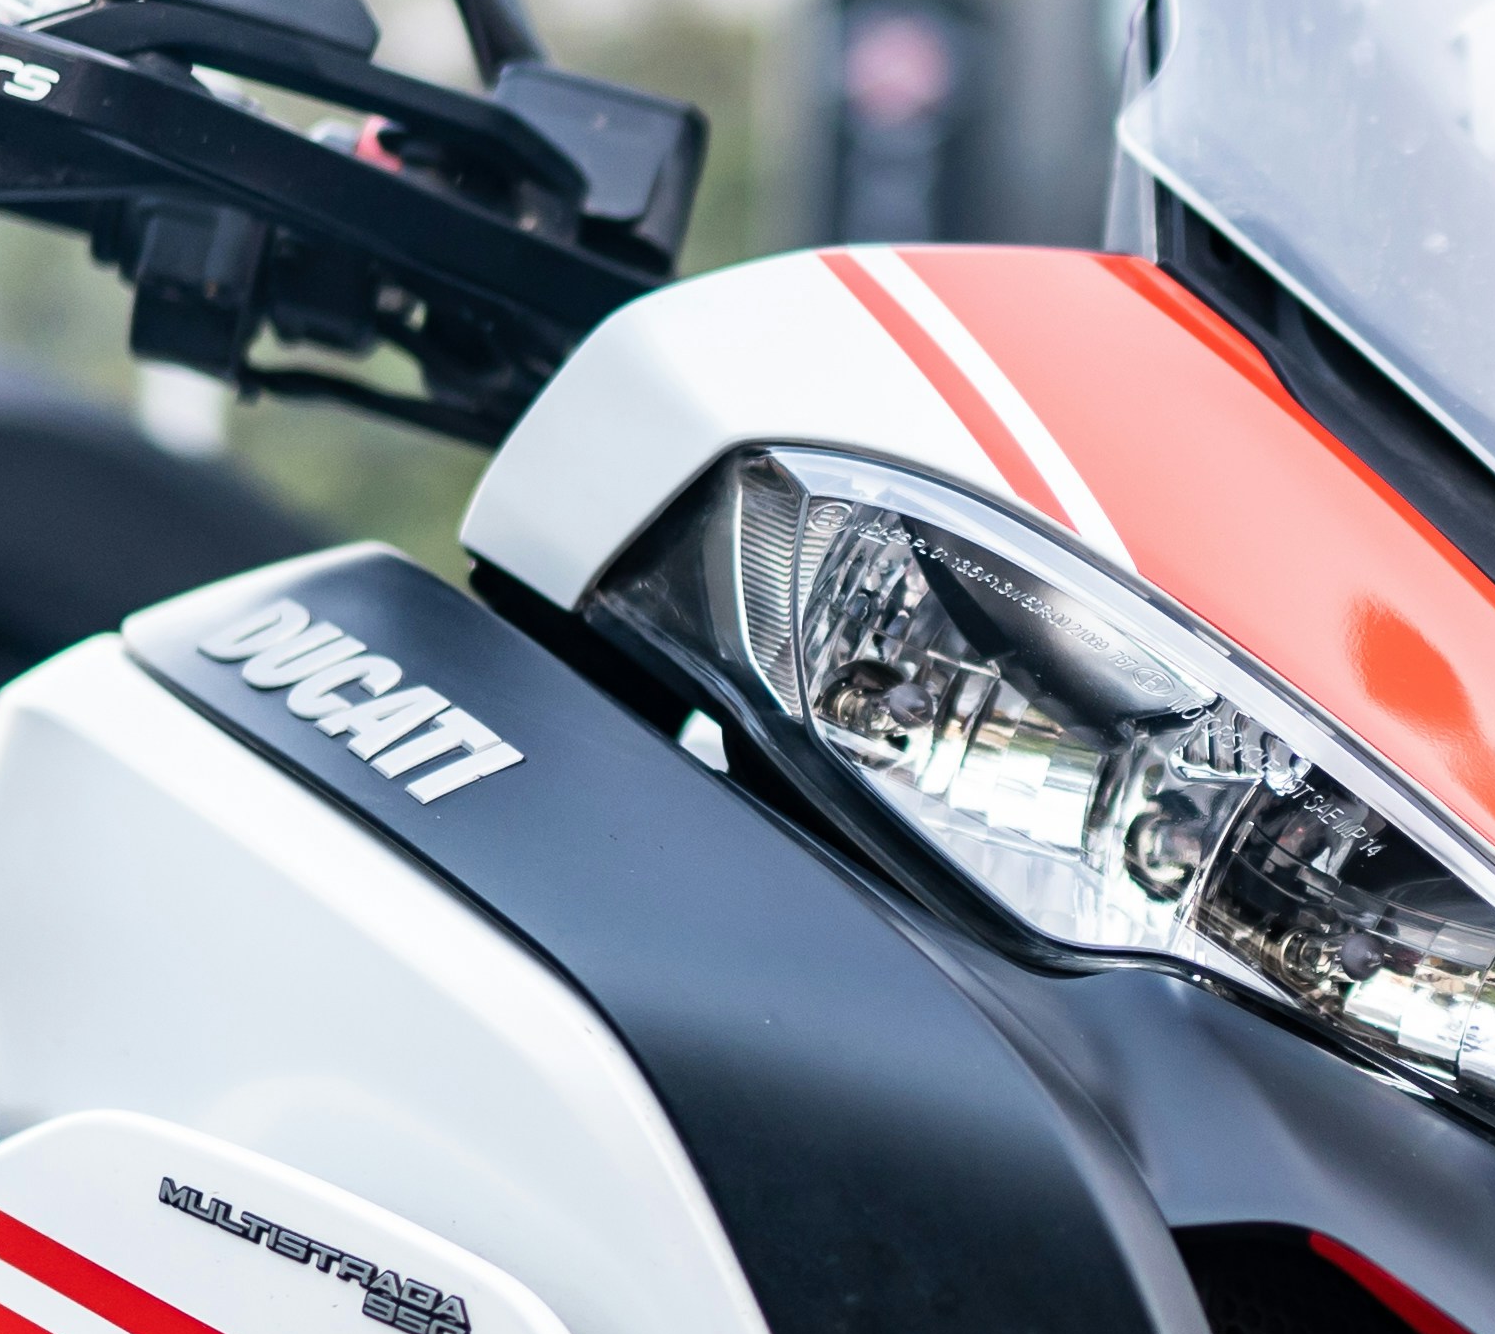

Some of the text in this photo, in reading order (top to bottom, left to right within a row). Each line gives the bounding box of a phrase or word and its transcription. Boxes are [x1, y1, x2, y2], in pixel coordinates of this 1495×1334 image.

[196, 598, 527, 805] DUCATI
[1303, 795, 1344, 824] SAE
[1332, 818, 1367, 838] MP
[1359, 838, 1384, 857] 14
[158, 1176, 471, 1329] MULTISTRADA
